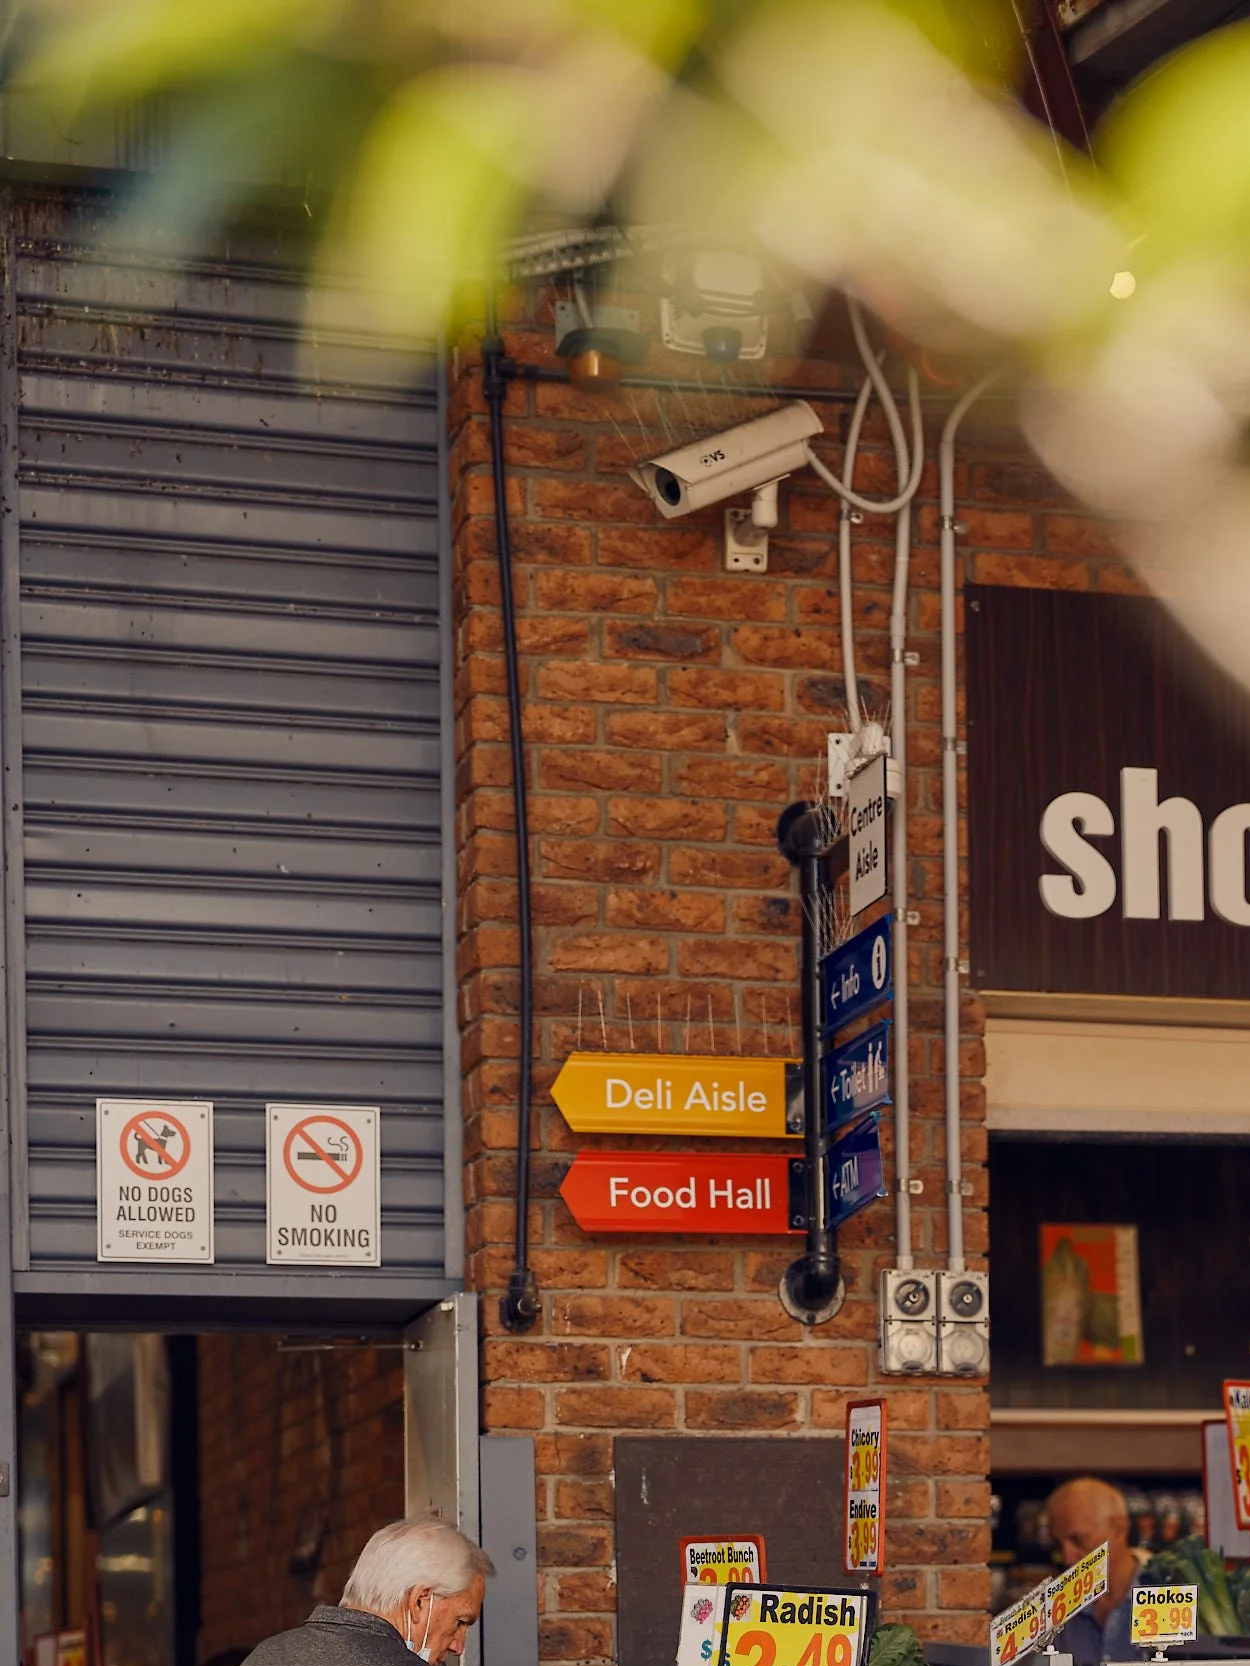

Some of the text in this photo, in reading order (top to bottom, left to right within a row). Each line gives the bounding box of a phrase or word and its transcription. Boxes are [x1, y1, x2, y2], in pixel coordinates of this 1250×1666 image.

[851, 796, 882, 837] Centre
[855, 840, 878, 882] Aisle
[841, 963, 860, 1001] Info
[840, 1062, 866, 1101] Toilet
[606, 1078, 768, 1113] Deli Aisle
[840, 1156, 859, 1197] ATM
[119, 1186, 193, 1203] NO DOGS
[609, 1176, 771, 1209] Food Hall
[116, 1205, 195, 1223] ALLOWED
[310, 1204, 338, 1223] NO
[118, 1229, 193, 1240] SERVICE DOGS
[277, 1227, 371, 1248] SMOKING
[136, 1242, 176, 1250] EXEMPT
[851, 1429, 879, 1449] Chicory
[850, 1500, 877, 1519] Endive
[689, 1546, 754, 1565] Beetroot Bunch
[1047, 1548, 1106, 1598] Spaghetti Squash
[1136, 1590, 1194, 1605] Chokos
[760, 1594, 856, 1627] Radish
